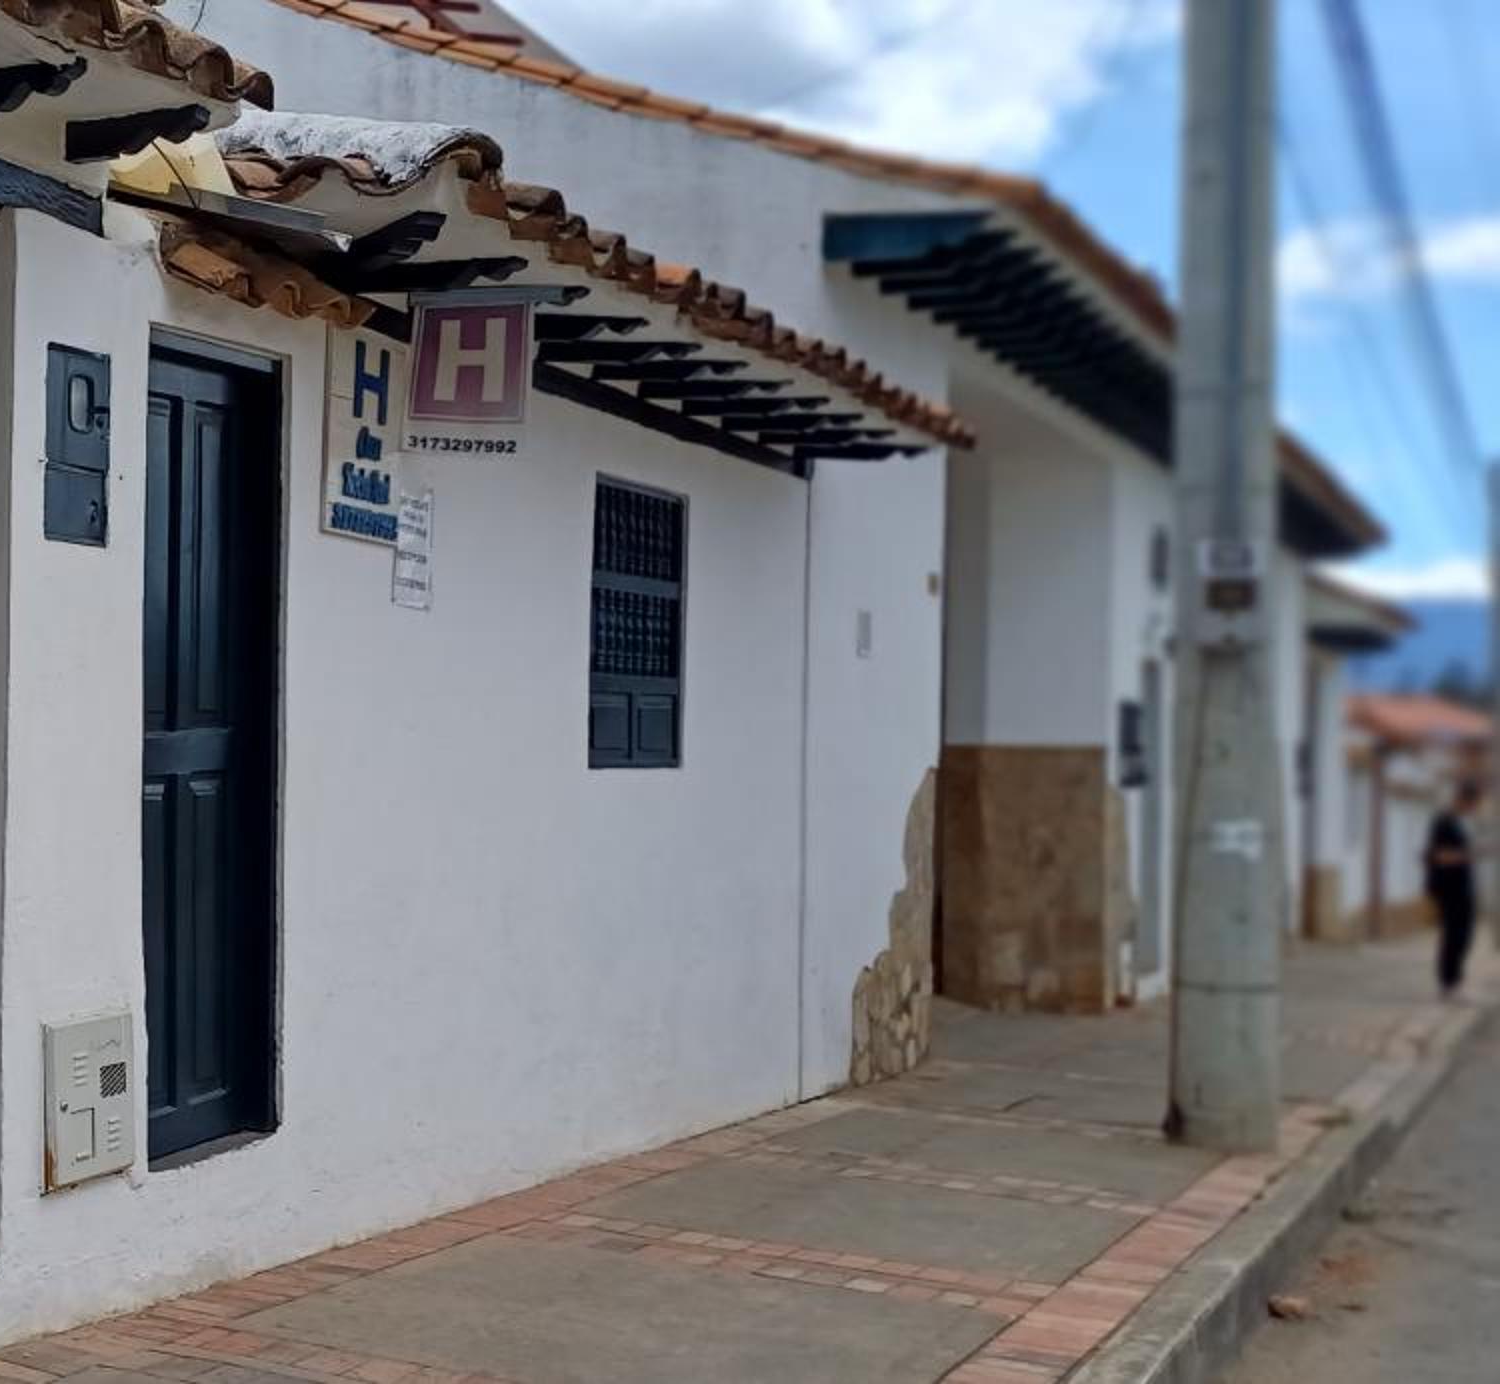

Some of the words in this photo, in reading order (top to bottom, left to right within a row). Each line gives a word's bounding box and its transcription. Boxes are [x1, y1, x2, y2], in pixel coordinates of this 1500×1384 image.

[353, 339, 390, 426] H
[434, 317, 507, 402] H
[407, 435, 517, 454] 3173297992
